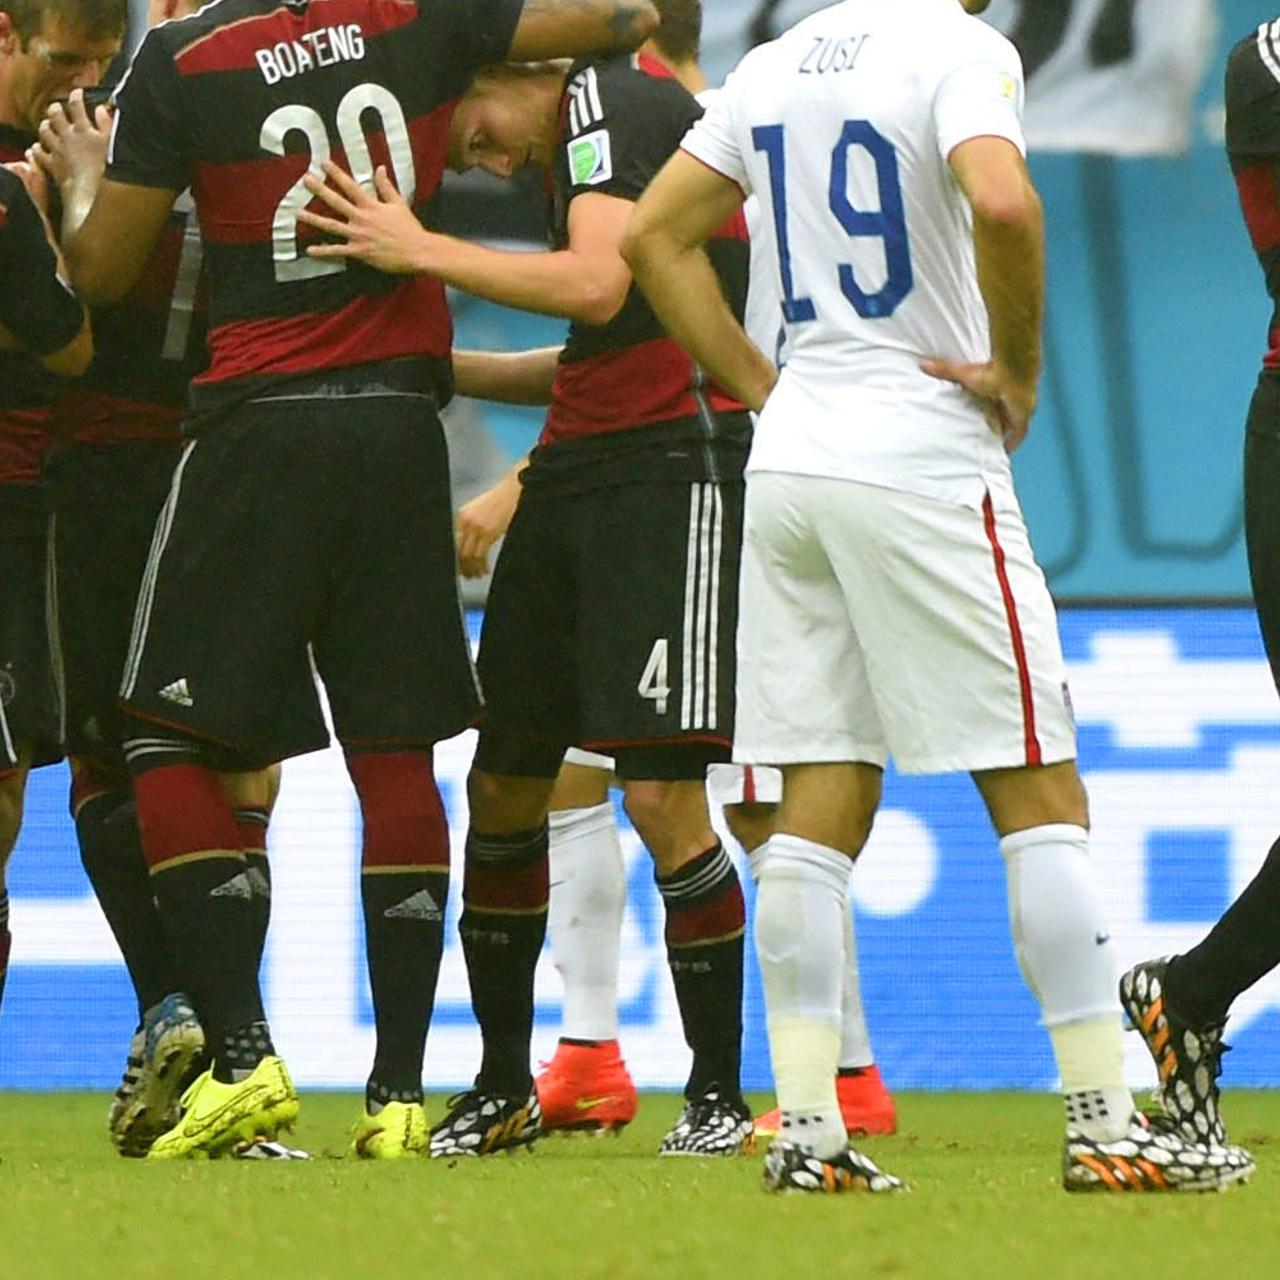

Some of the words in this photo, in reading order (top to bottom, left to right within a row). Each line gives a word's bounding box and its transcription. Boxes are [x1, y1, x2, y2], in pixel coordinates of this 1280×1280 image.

[255, 24, 366, 85] BOATENG
[260, 83, 417, 283] 20
[751, 119, 915, 324] 19
[637, 638, 671, 715] 4
